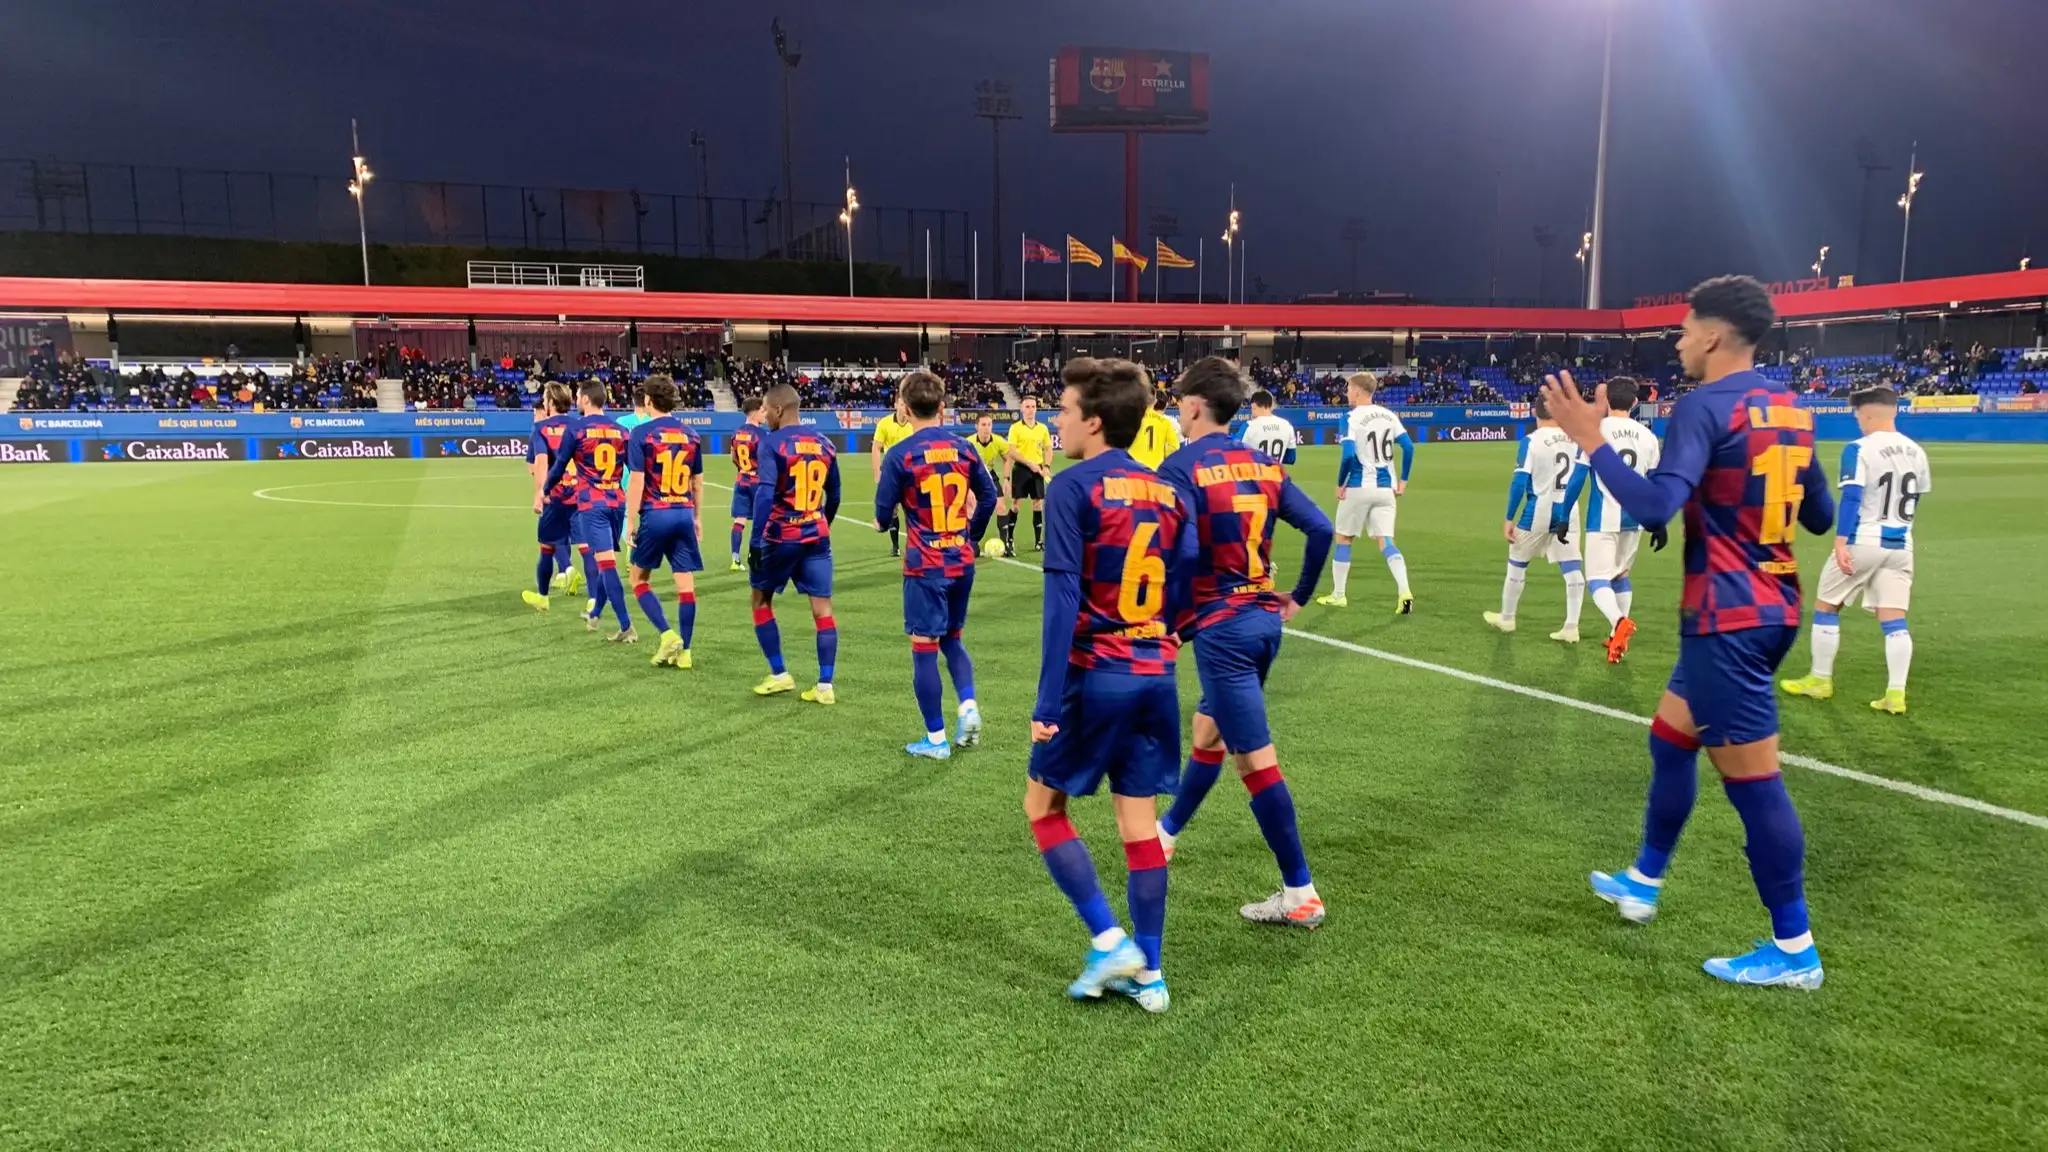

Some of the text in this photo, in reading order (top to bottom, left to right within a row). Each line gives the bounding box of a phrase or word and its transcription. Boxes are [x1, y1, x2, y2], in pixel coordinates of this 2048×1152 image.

[1142, 78, 1185, 89] ESTRELLA
[35, 419, 103, 428] FC BARCELONA
[180, 419, 198, 428] QUE
[200, 419, 213, 427] UN
[214, 419, 237, 427] CLUB
[304, 418, 365, 427] FC BARCELONA
[434, 418, 450, 427] QUE
[451, 417, 463, 426] UN
[464, 417, 485, 426] CLUB
[1450, 426, 1507, 440] CaixaBank
[127, 441, 230, 460] CaixaBank
[300, 440, 395, 457] CaixaBank
[461, 439, 529, 456] CaixaBa
[1145, 425, 1154, 451] 1
[1259, 439, 1284, 461] 19
[1367, 428, 1393, 463] 16
[594, 443, 616, 480] 9
[737, 444, 752, 471] 8
[656, 450, 691, 495] 16
[1555, 452, 1570, 490] 2
[789, 461, 828, 511] 18
[1878, 472, 1918, 521] 18
[920, 472, 968, 533] 12
[1232, 494, 1268, 579] 7
[1118, 522, 1166, 624] 6
